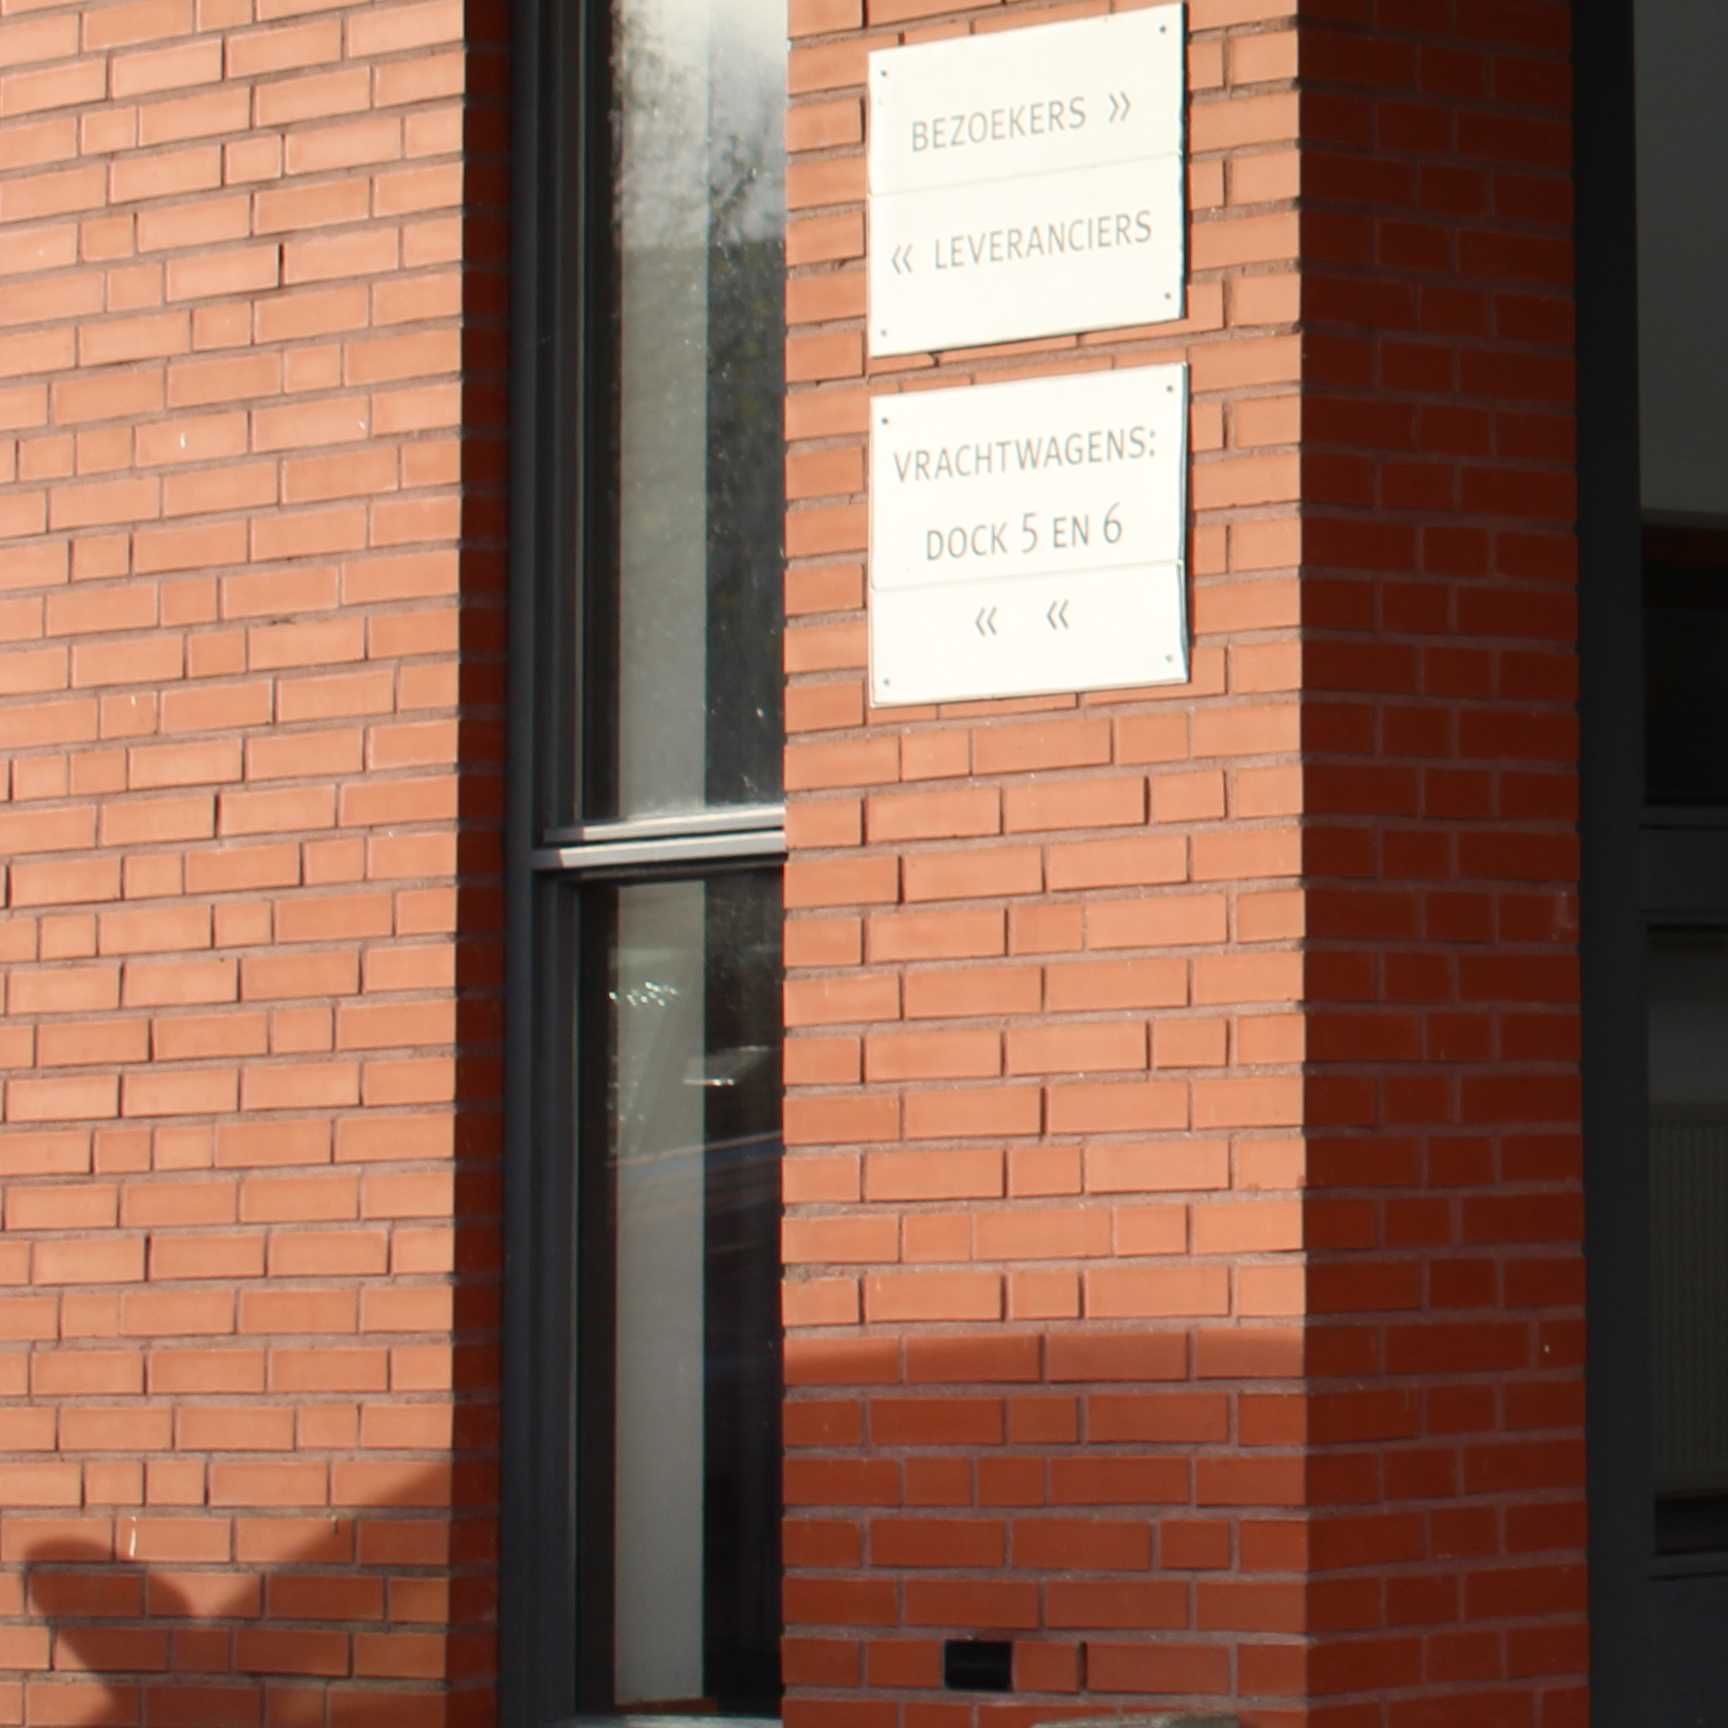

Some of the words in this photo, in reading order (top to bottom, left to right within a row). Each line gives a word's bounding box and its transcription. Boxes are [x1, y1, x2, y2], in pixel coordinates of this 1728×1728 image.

[911, 95, 1087, 153] BEZOEKERS
[934, 209, 1153, 271] LEVERANCIERS
[893, 424, 1156, 483] VRACHTWAGENS:
[925, 522, 1009, 561] DOCK
[1020, 511, 1039, 554] 5
[1053, 514, 1090, 549] EN
[1102, 501, 1123, 545] 6
